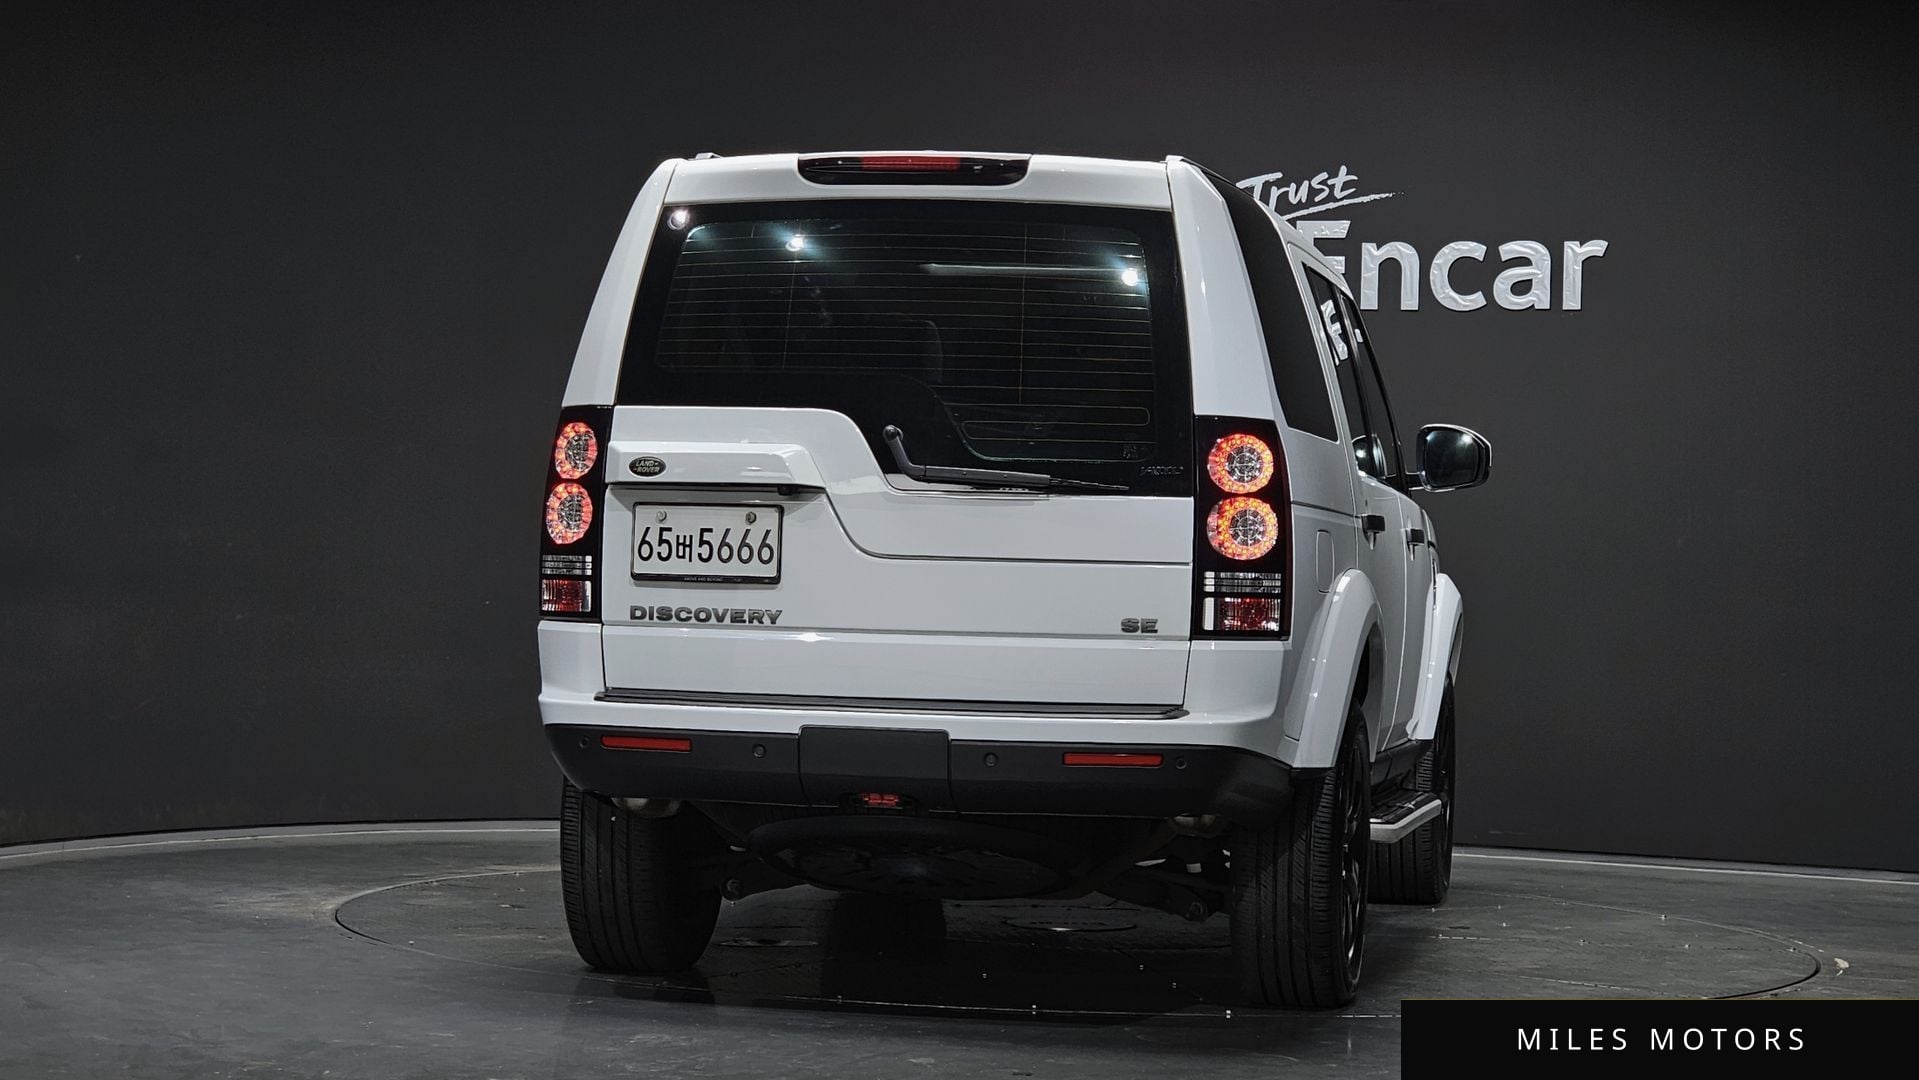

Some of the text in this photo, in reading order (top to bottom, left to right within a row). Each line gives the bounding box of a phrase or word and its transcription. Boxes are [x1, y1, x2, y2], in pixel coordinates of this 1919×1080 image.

[1236, 165, 1358, 212] Trust
[637, 526, 775, 565] 65버5666
[629, 605, 783, 625] DISCOVERY
[1121, 617, 1159, 634] SE
